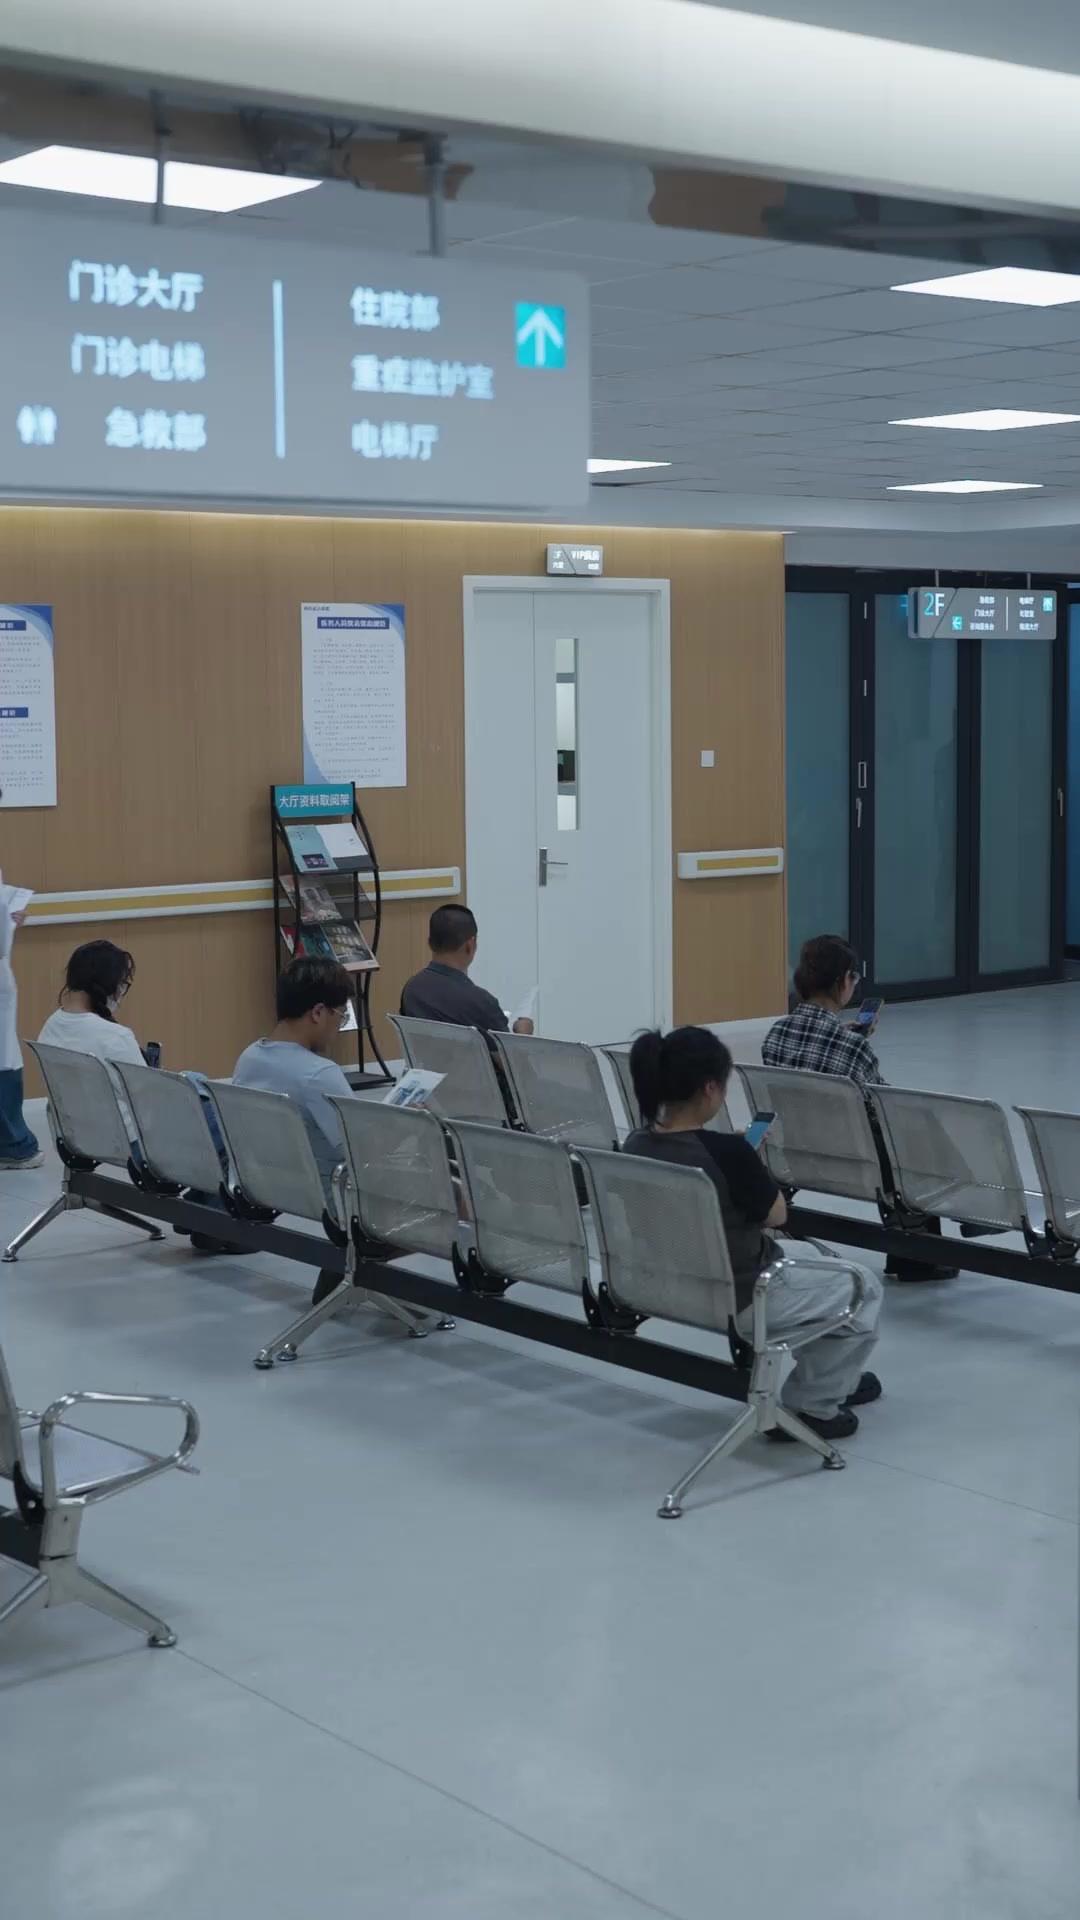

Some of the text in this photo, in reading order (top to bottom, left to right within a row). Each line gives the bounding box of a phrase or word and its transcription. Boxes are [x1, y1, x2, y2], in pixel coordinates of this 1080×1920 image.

[69, 259, 204, 313] 门诊大厅
[351, 287, 440, 331] 住院部
[70, 334, 206, 382] 门诊电梯
[351, 354, 495, 400] 重症监护室
[105, 406, 207, 451] 急救部
[351, 418, 439, 461] 电梯厅
[924, 593, 945, 616] 2F
[279, 793, 351, 809] 大厅资料取阅架
